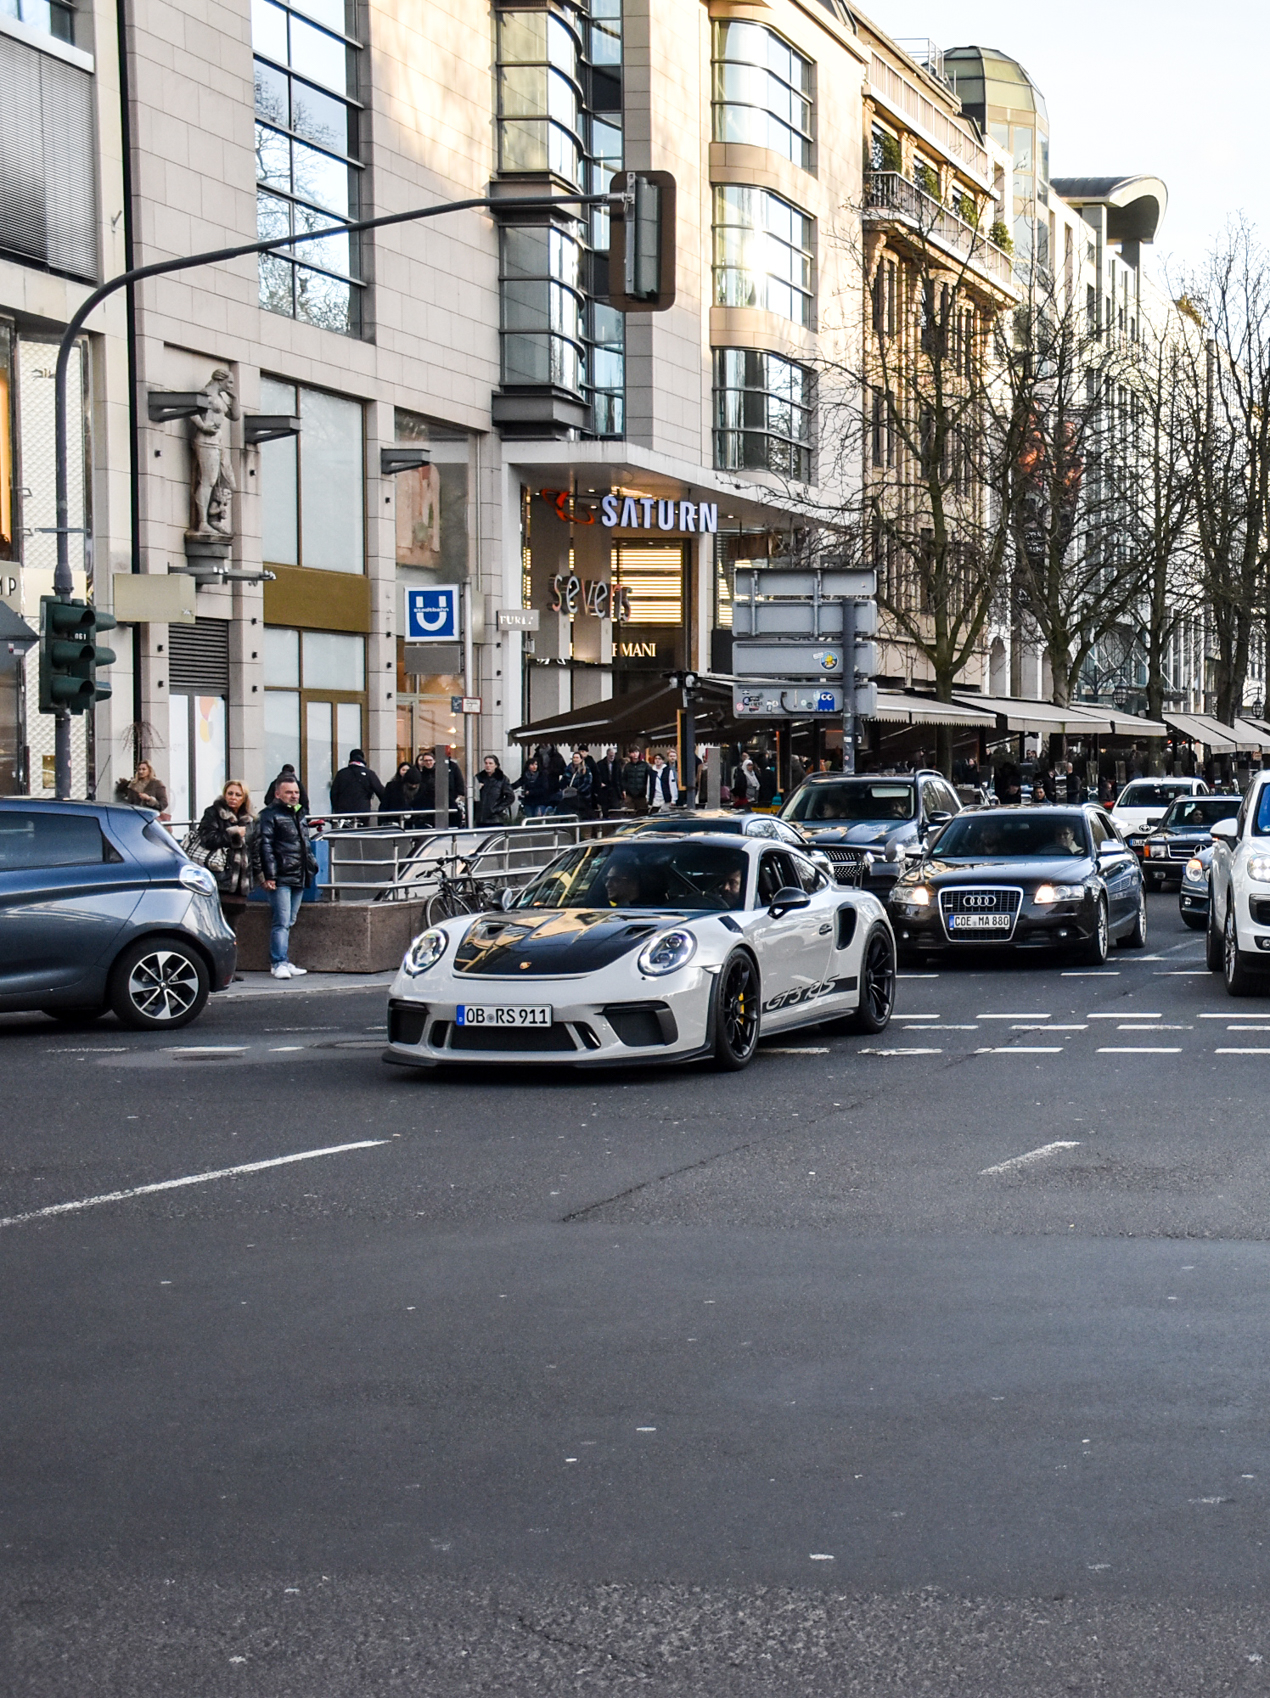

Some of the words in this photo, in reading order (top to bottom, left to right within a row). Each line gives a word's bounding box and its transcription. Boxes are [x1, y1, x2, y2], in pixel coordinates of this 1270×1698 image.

[601, 495, 718, 533] SATURN
[955, 916, 971, 926] COE
[978, 916, 990, 926] MA
[992, 915, 1009, 926] 880
[766, 987, 802, 1010] GT3
[805, 974, 840, 1000] RS
[466, 1008, 485, 1023] OB
[495, 1008, 515, 1023] RS
[520, 1008, 548, 1024] 911
